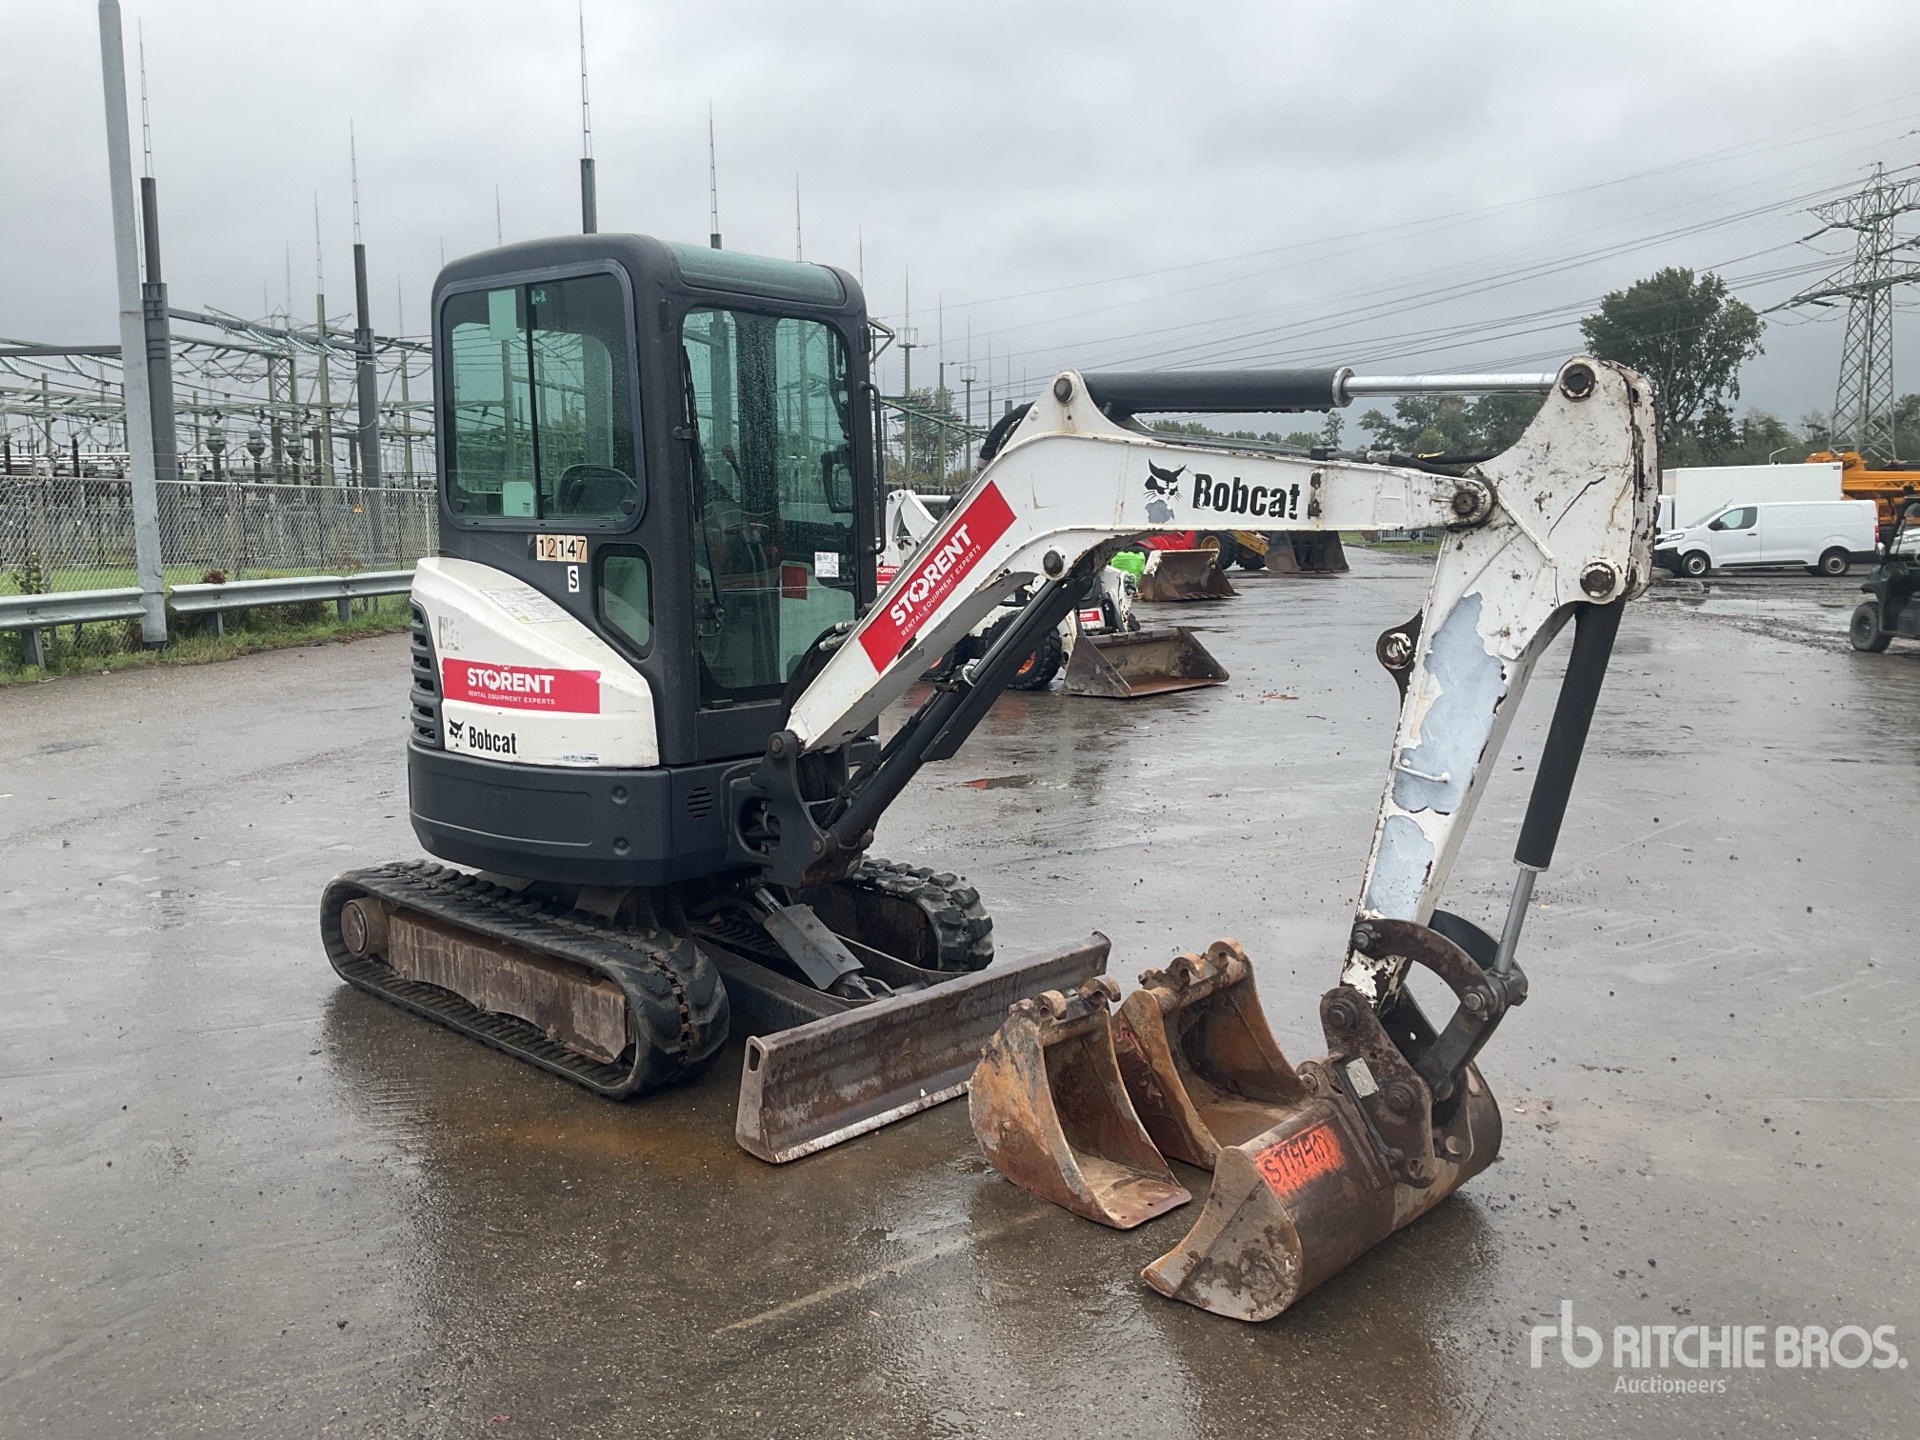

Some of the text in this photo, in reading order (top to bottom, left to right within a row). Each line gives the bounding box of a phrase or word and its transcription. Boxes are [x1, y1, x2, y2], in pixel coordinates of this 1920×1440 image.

[1192, 473, 1300, 520] Bobcat
[539, 538, 586, 560] 12147
[569, 569, 578, 589] S
[890, 523, 972, 627] STORENT
[901, 543, 982, 637] RENTAL EQUIPMENT EXPERTS
[467, 667, 555, 694] STORENT
[468, 690, 556, 705] RENTAL EQUIPMENT EXPERTS
[469, 725, 517, 755] Bobcat
